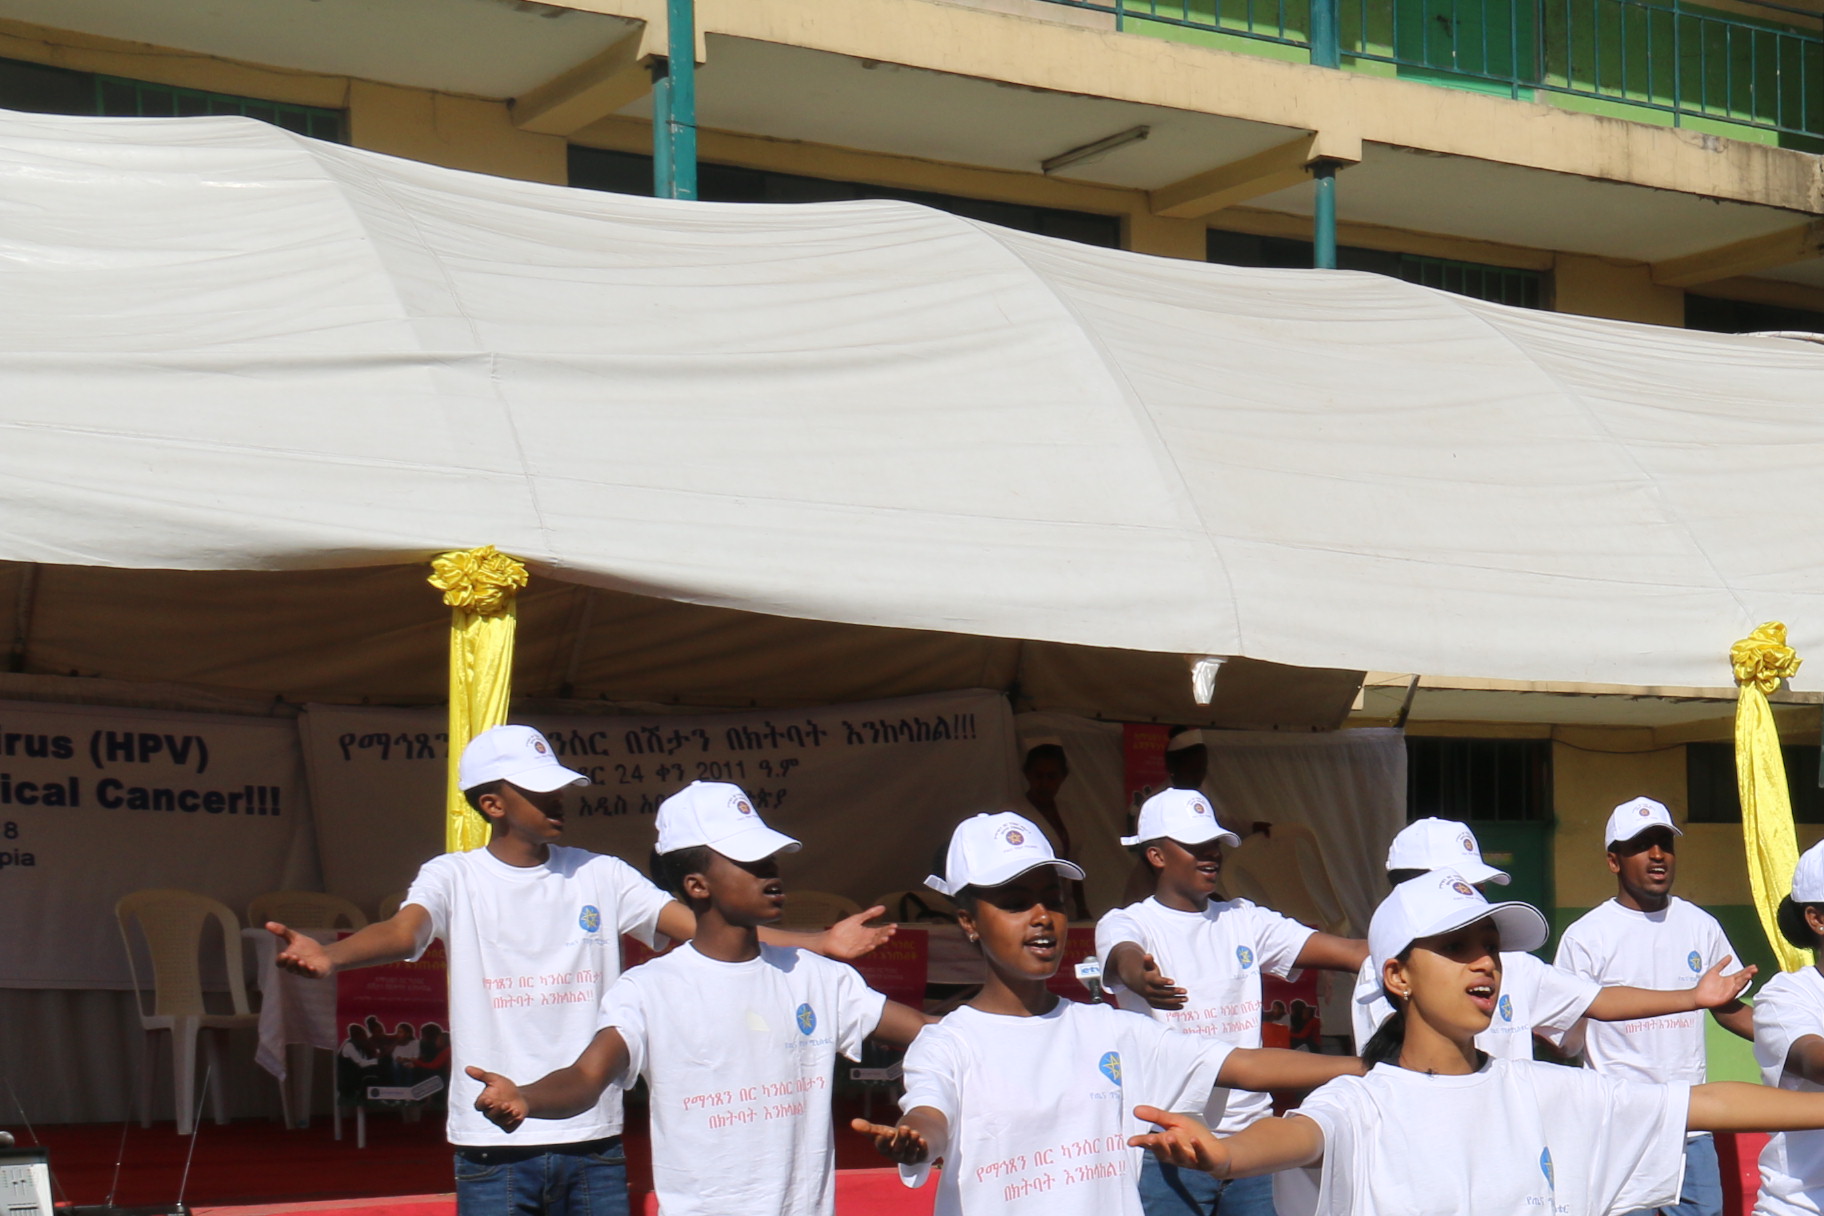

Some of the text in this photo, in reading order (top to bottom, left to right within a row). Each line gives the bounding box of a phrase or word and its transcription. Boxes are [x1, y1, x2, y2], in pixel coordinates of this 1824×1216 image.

[625, 726, 710, 755] በሽታን
[727, 719, 828, 751] በክትባት
[842, 713, 977, 746] እንከላከል!!!
[0, 730, 208, 774] rus (HPV)
[615, 764, 645, 784] 24
[656, 763, 684, 782] ቀን
[697, 760, 746, 781] 2011
[97, 778, 281, 816] Cancer!!!
[580, 795, 627, 816] አዲስ
[4, 822, 18, 839] 8
[683, 1091, 734, 1111] የማኅጸን
[740, 1085, 757, 1102] በር
[709, 1103, 758, 1129] በክትባት
[976, 1155, 1027, 1182] የማኅጸን
[1034, 1148, 1055, 1168] በር
[1004, 1172, 1056, 1202] በክትባት
